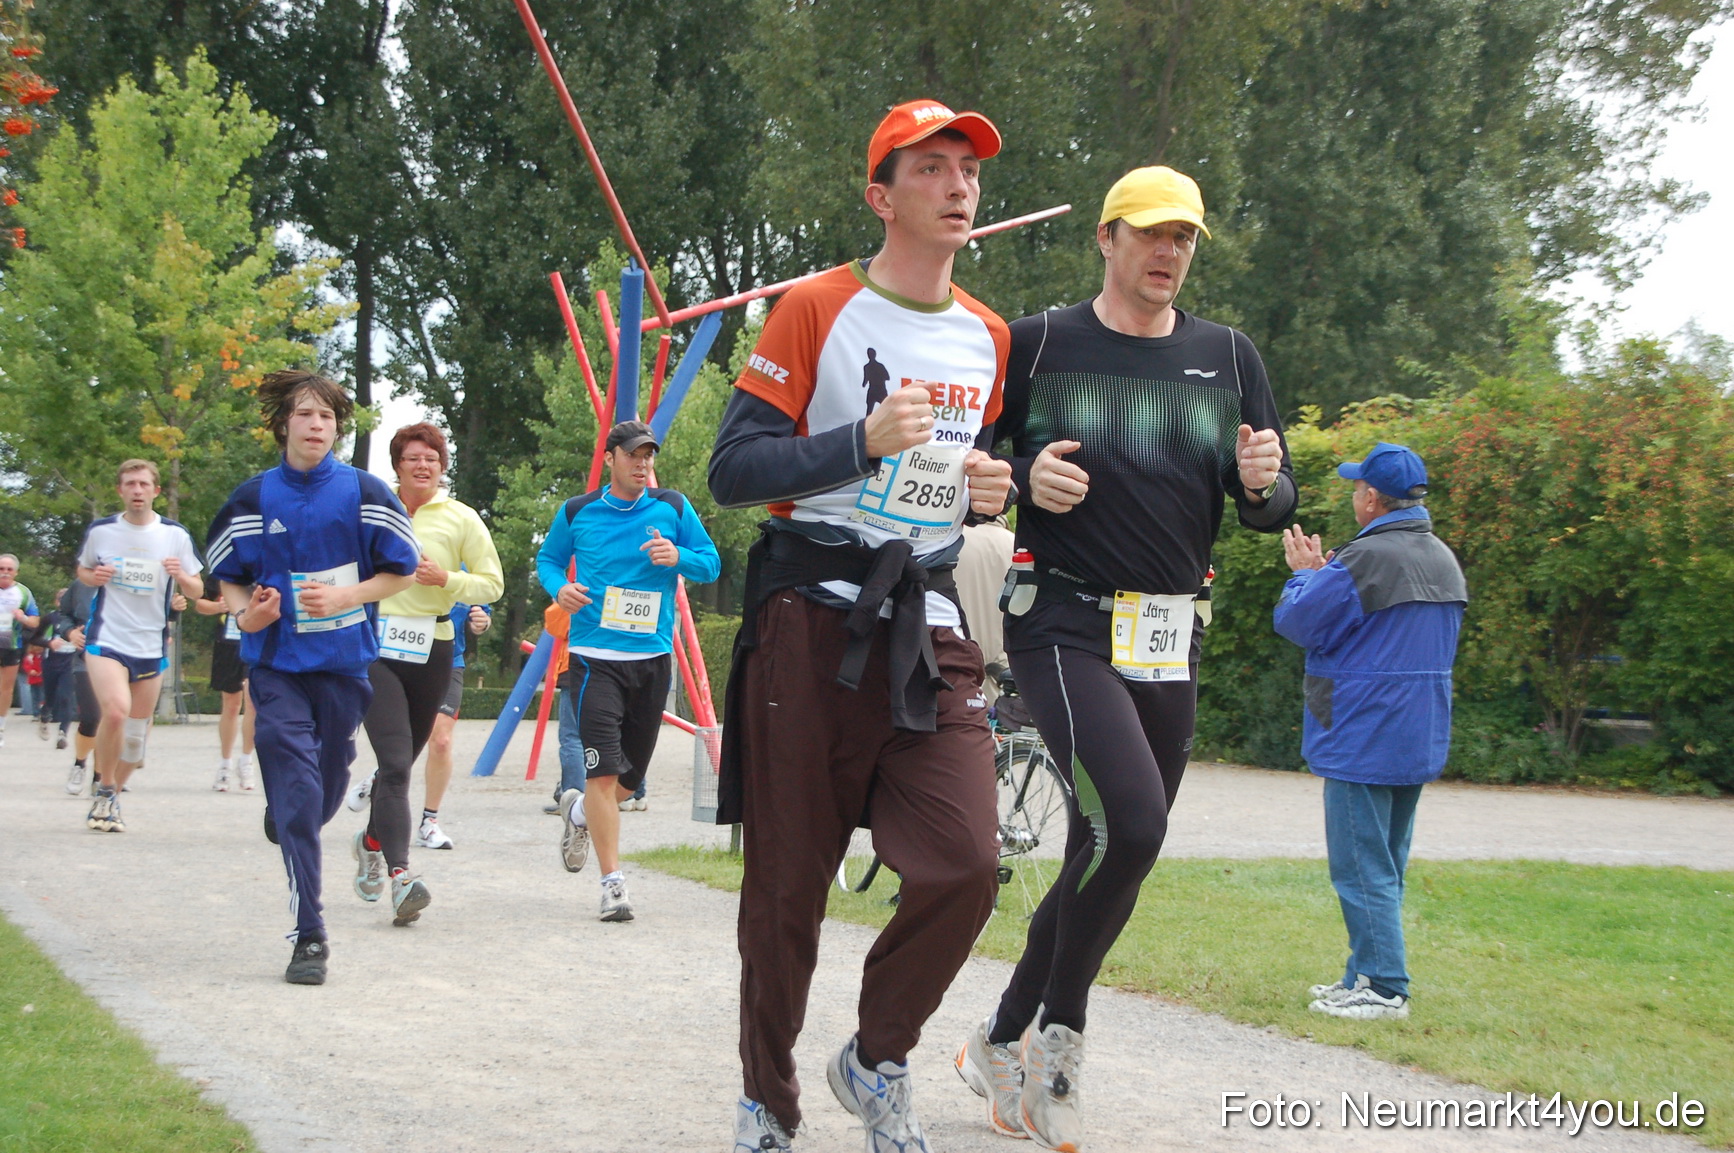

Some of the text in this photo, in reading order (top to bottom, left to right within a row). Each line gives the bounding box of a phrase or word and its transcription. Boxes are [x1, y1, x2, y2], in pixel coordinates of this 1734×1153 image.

[901, 377, 981, 411] ERZ
[935, 429, 972, 444] 2008
[908, 451, 950, 475] Rainer
[898, 479, 957, 509] 2859
[125, 571, 154, 583] 2909
[622, 589, 652, 600] Andreas
[624, 602, 651, 617] 260
[1143, 602, 1170, 622] Jörg
[388, 627, 426, 646] 3496
[1116, 624, 1122, 637] C
[1149, 629, 1178, 653] 501
